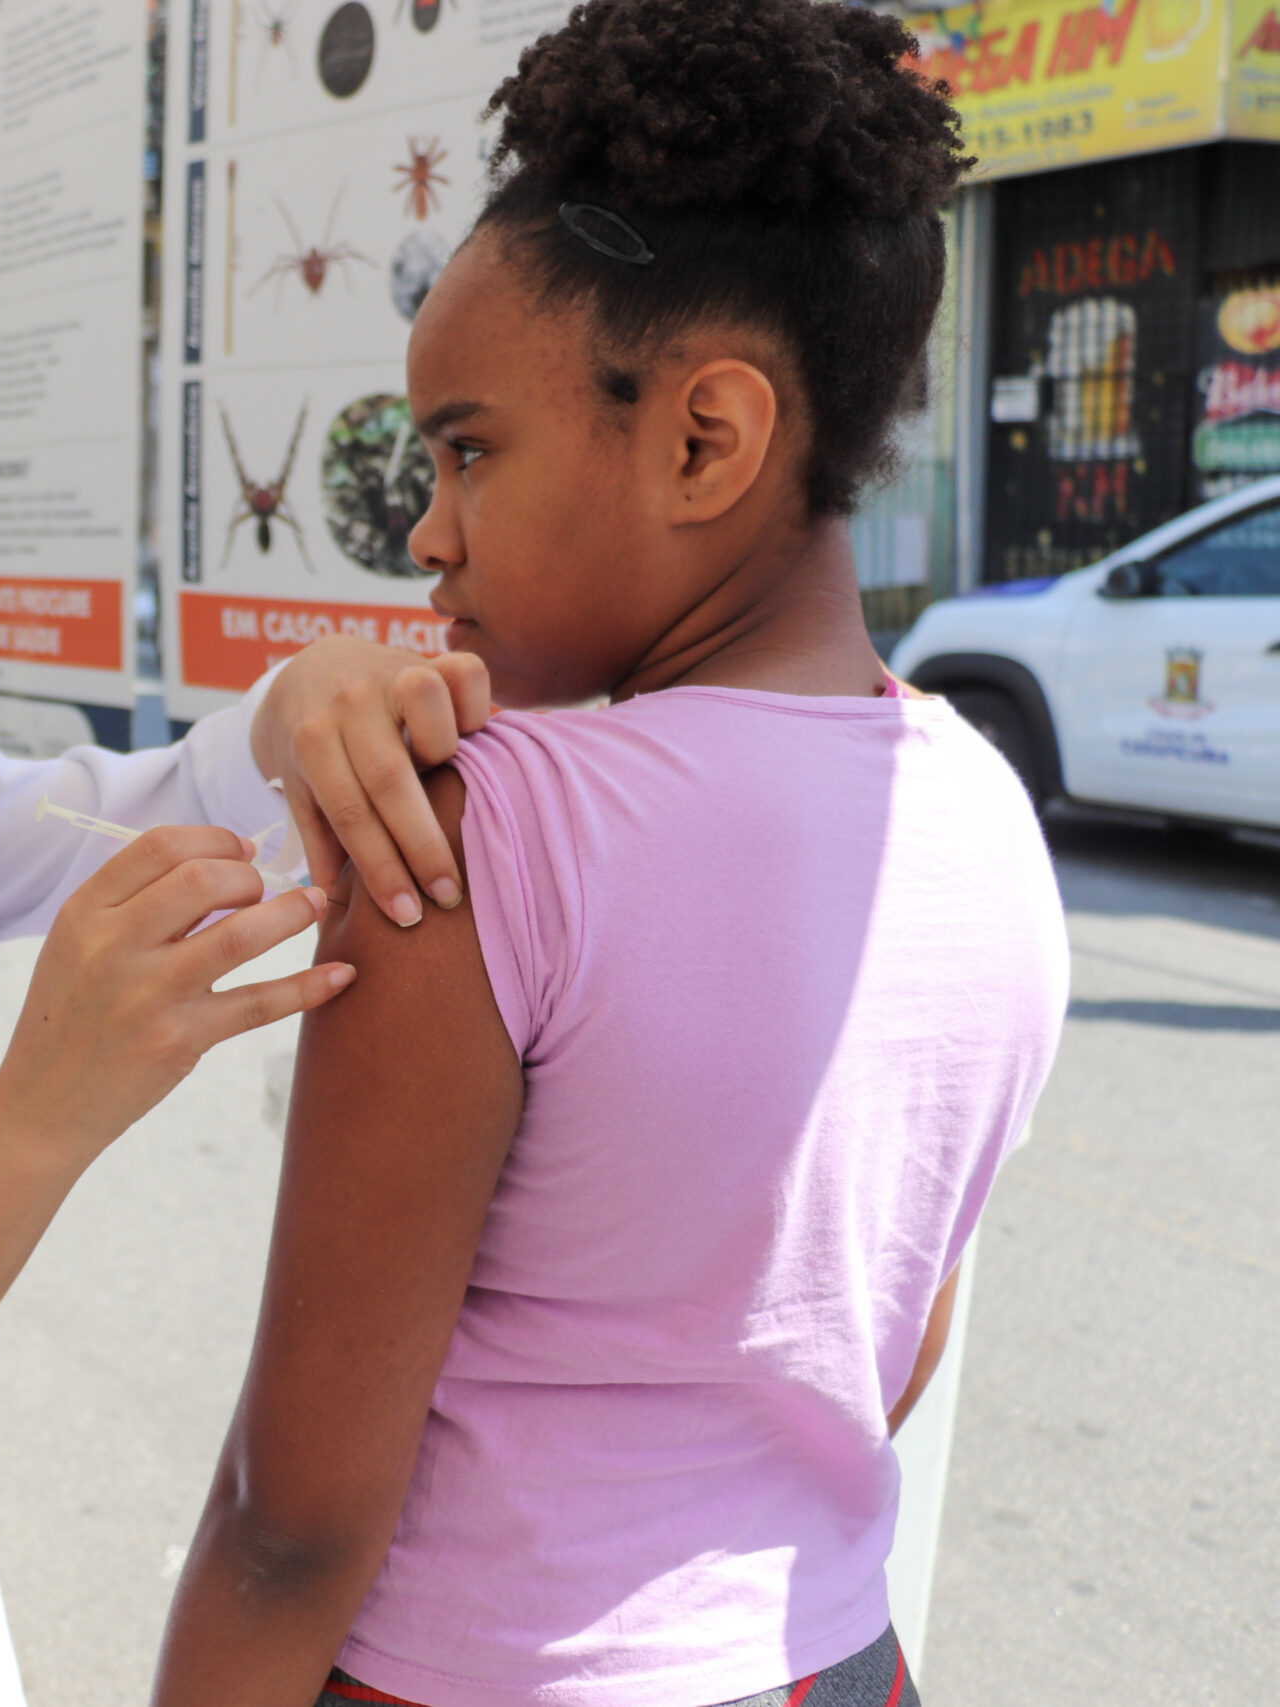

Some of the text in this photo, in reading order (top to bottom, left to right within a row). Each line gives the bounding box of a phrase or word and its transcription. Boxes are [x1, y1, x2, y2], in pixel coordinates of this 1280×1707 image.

[1020, 228, 1177, 296] ADEGA
[221, 607, 259, 639] EM
[263, 609, 335, 644] CASO
[339, 616, 379, 643] DE
